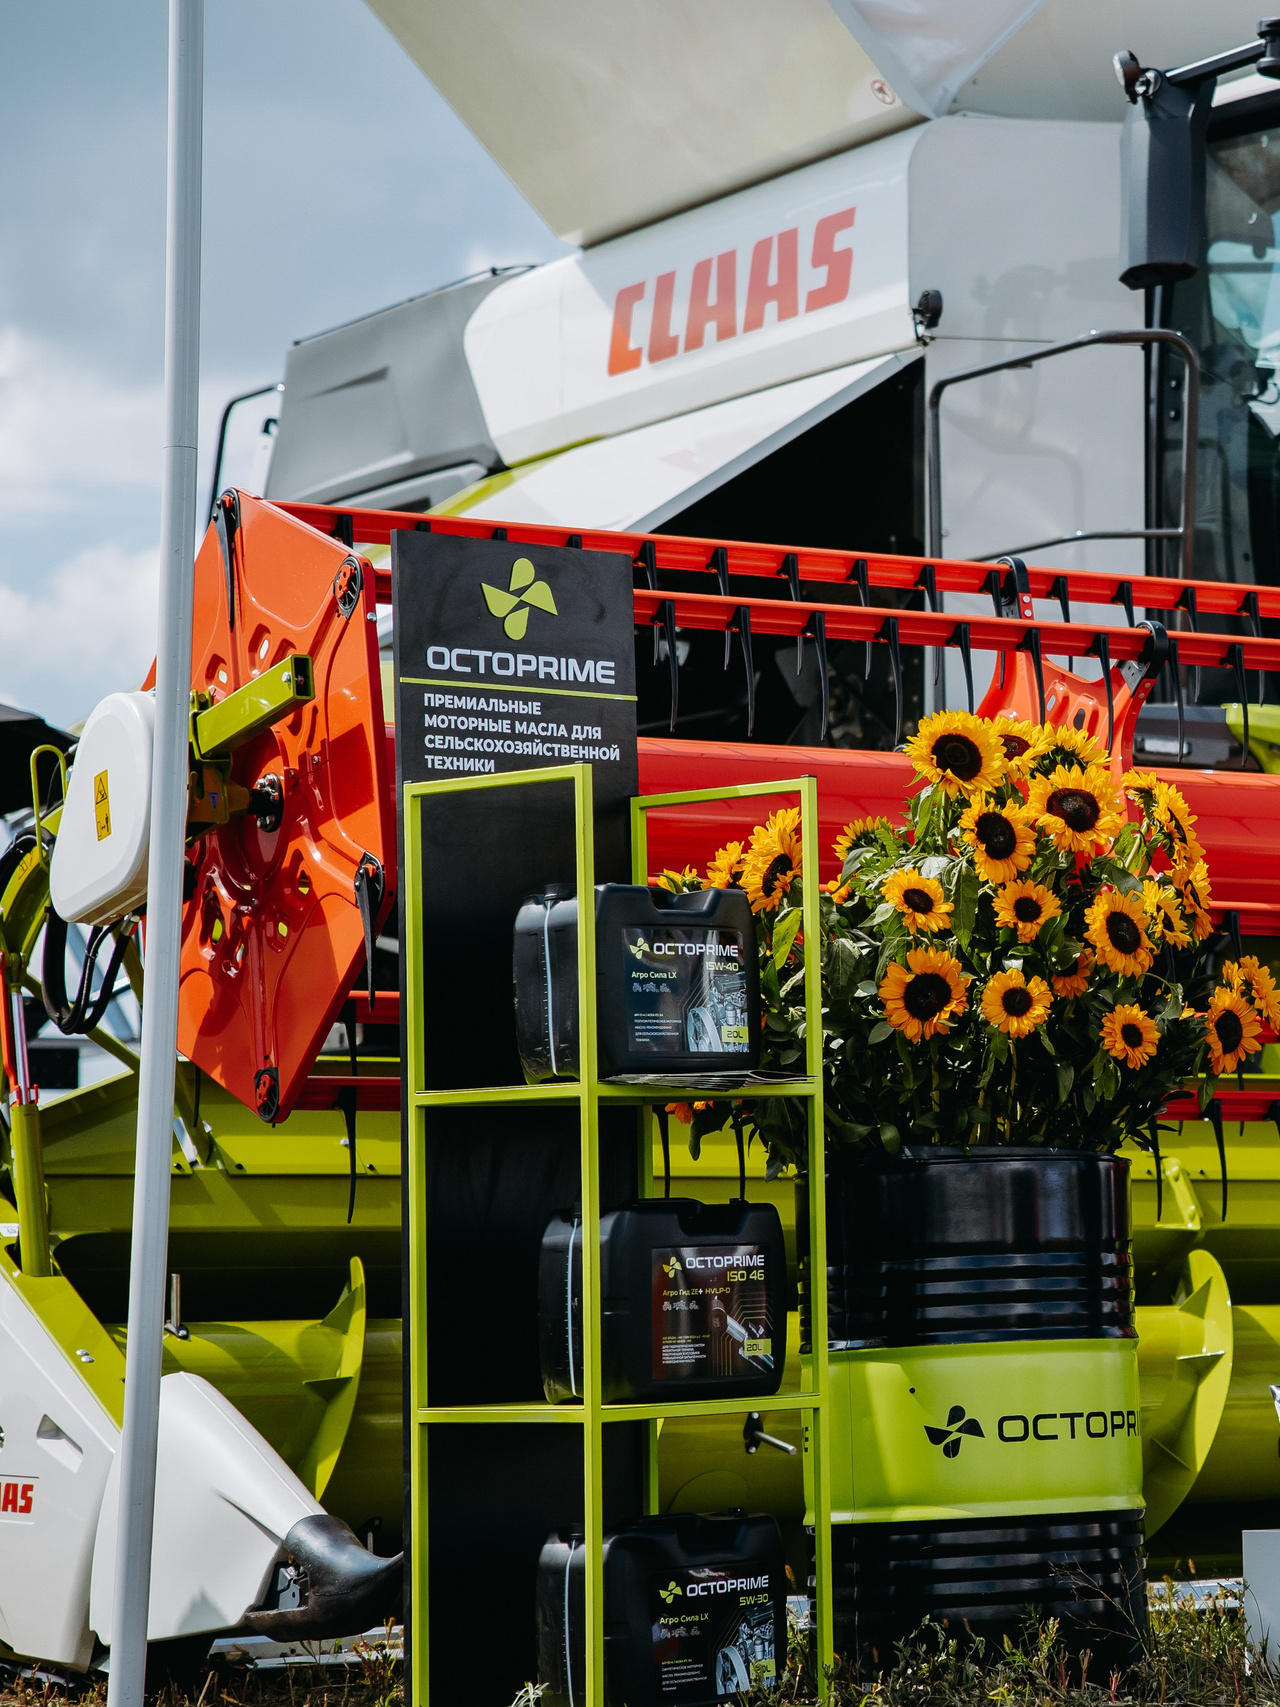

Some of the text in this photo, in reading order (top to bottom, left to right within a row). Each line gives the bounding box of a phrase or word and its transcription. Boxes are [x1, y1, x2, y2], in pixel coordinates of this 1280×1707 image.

[607, 206, 857, 377] CLAAS
[426, 645, 616, 685] OCTOPRIME
[423, 692, 542, 716] ПРЕМИАЛЬНЫЕ
[424, 713, 602, 741] МОТОРНЫЕ МАСЛА ДЛЯ
[424, 734, 620, 761] СЕЛЬСКОХОЗЯЙСТВЕННОЙ
[424, 754, 495, 773] ТЕХНИКИ
[653, 942, 739, 957] OCTOPRIME
[705, 961, 739, 972] 15W-40
[631, 971, 677, 980] Агро Сила LX
[726, 1030, 744, 1039] 20L
[685, 1254, 765, 1269] OCTOPRIME
[726, 1269, 765, 1282] ISO 46
[662, 1289, 678, 1298] Агро
[746, 1343, 763, 1352] 20L
[0, 1482, 34, 1514] AS
[686, 1575, 769, 1597] OCTOPRIME
[739, 1593, 769, 1606] 5W-30
[660, 1612, 709, 1626] Агро Сила LX
